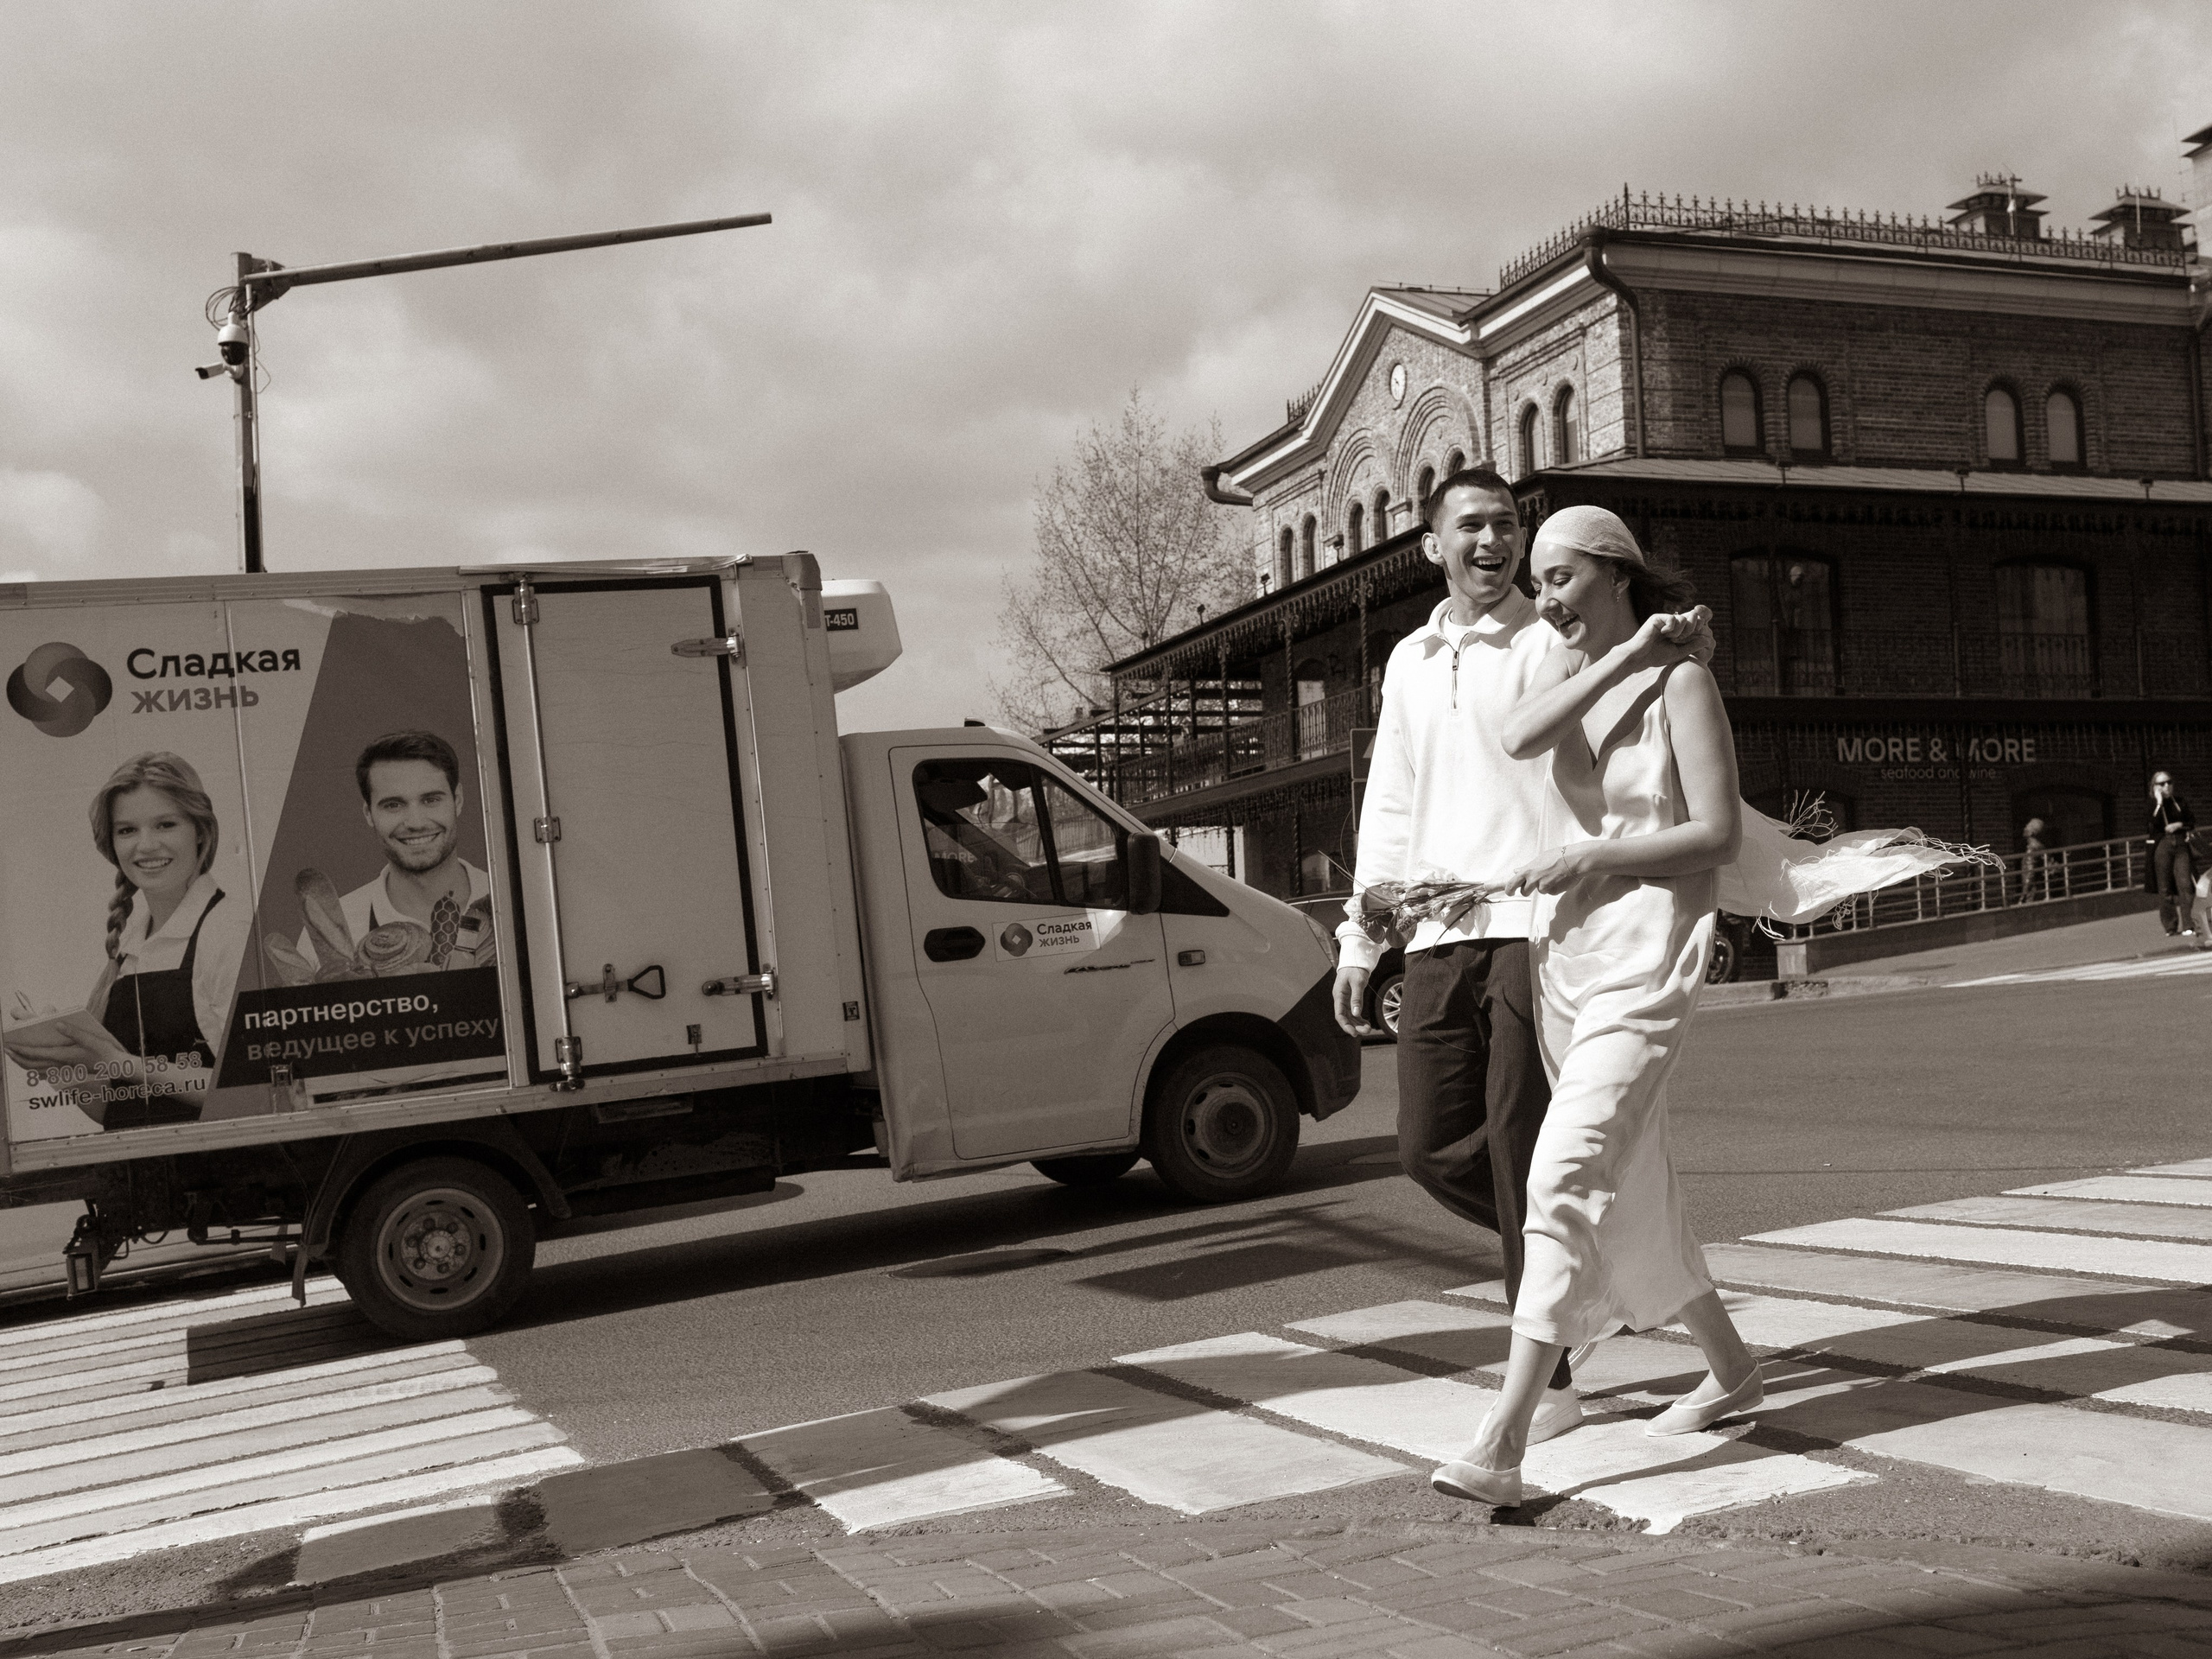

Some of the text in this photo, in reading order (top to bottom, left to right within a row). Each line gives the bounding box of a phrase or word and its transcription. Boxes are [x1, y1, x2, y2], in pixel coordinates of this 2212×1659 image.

[127, 648, 301, 679] Сладкая
[130, 685, 259, 714] жизнь
[1837, 737, 1921, 762] MORE
[1929, 737, 1948, 762] &
[1881, 765, 1935, 779] seafood
[1037, 921, 1092, 935] Сладкая
[1039, 936, 1080, 947] жизнь
[244, 995, 438, 1030] партнерство,
[247, 1018, 499, 1060] ведущее к успеху
[26, 1051, 202, 1087] 8 800 200 58 58
[29, 1078, 206, 1109] swlife-horeca.ru
